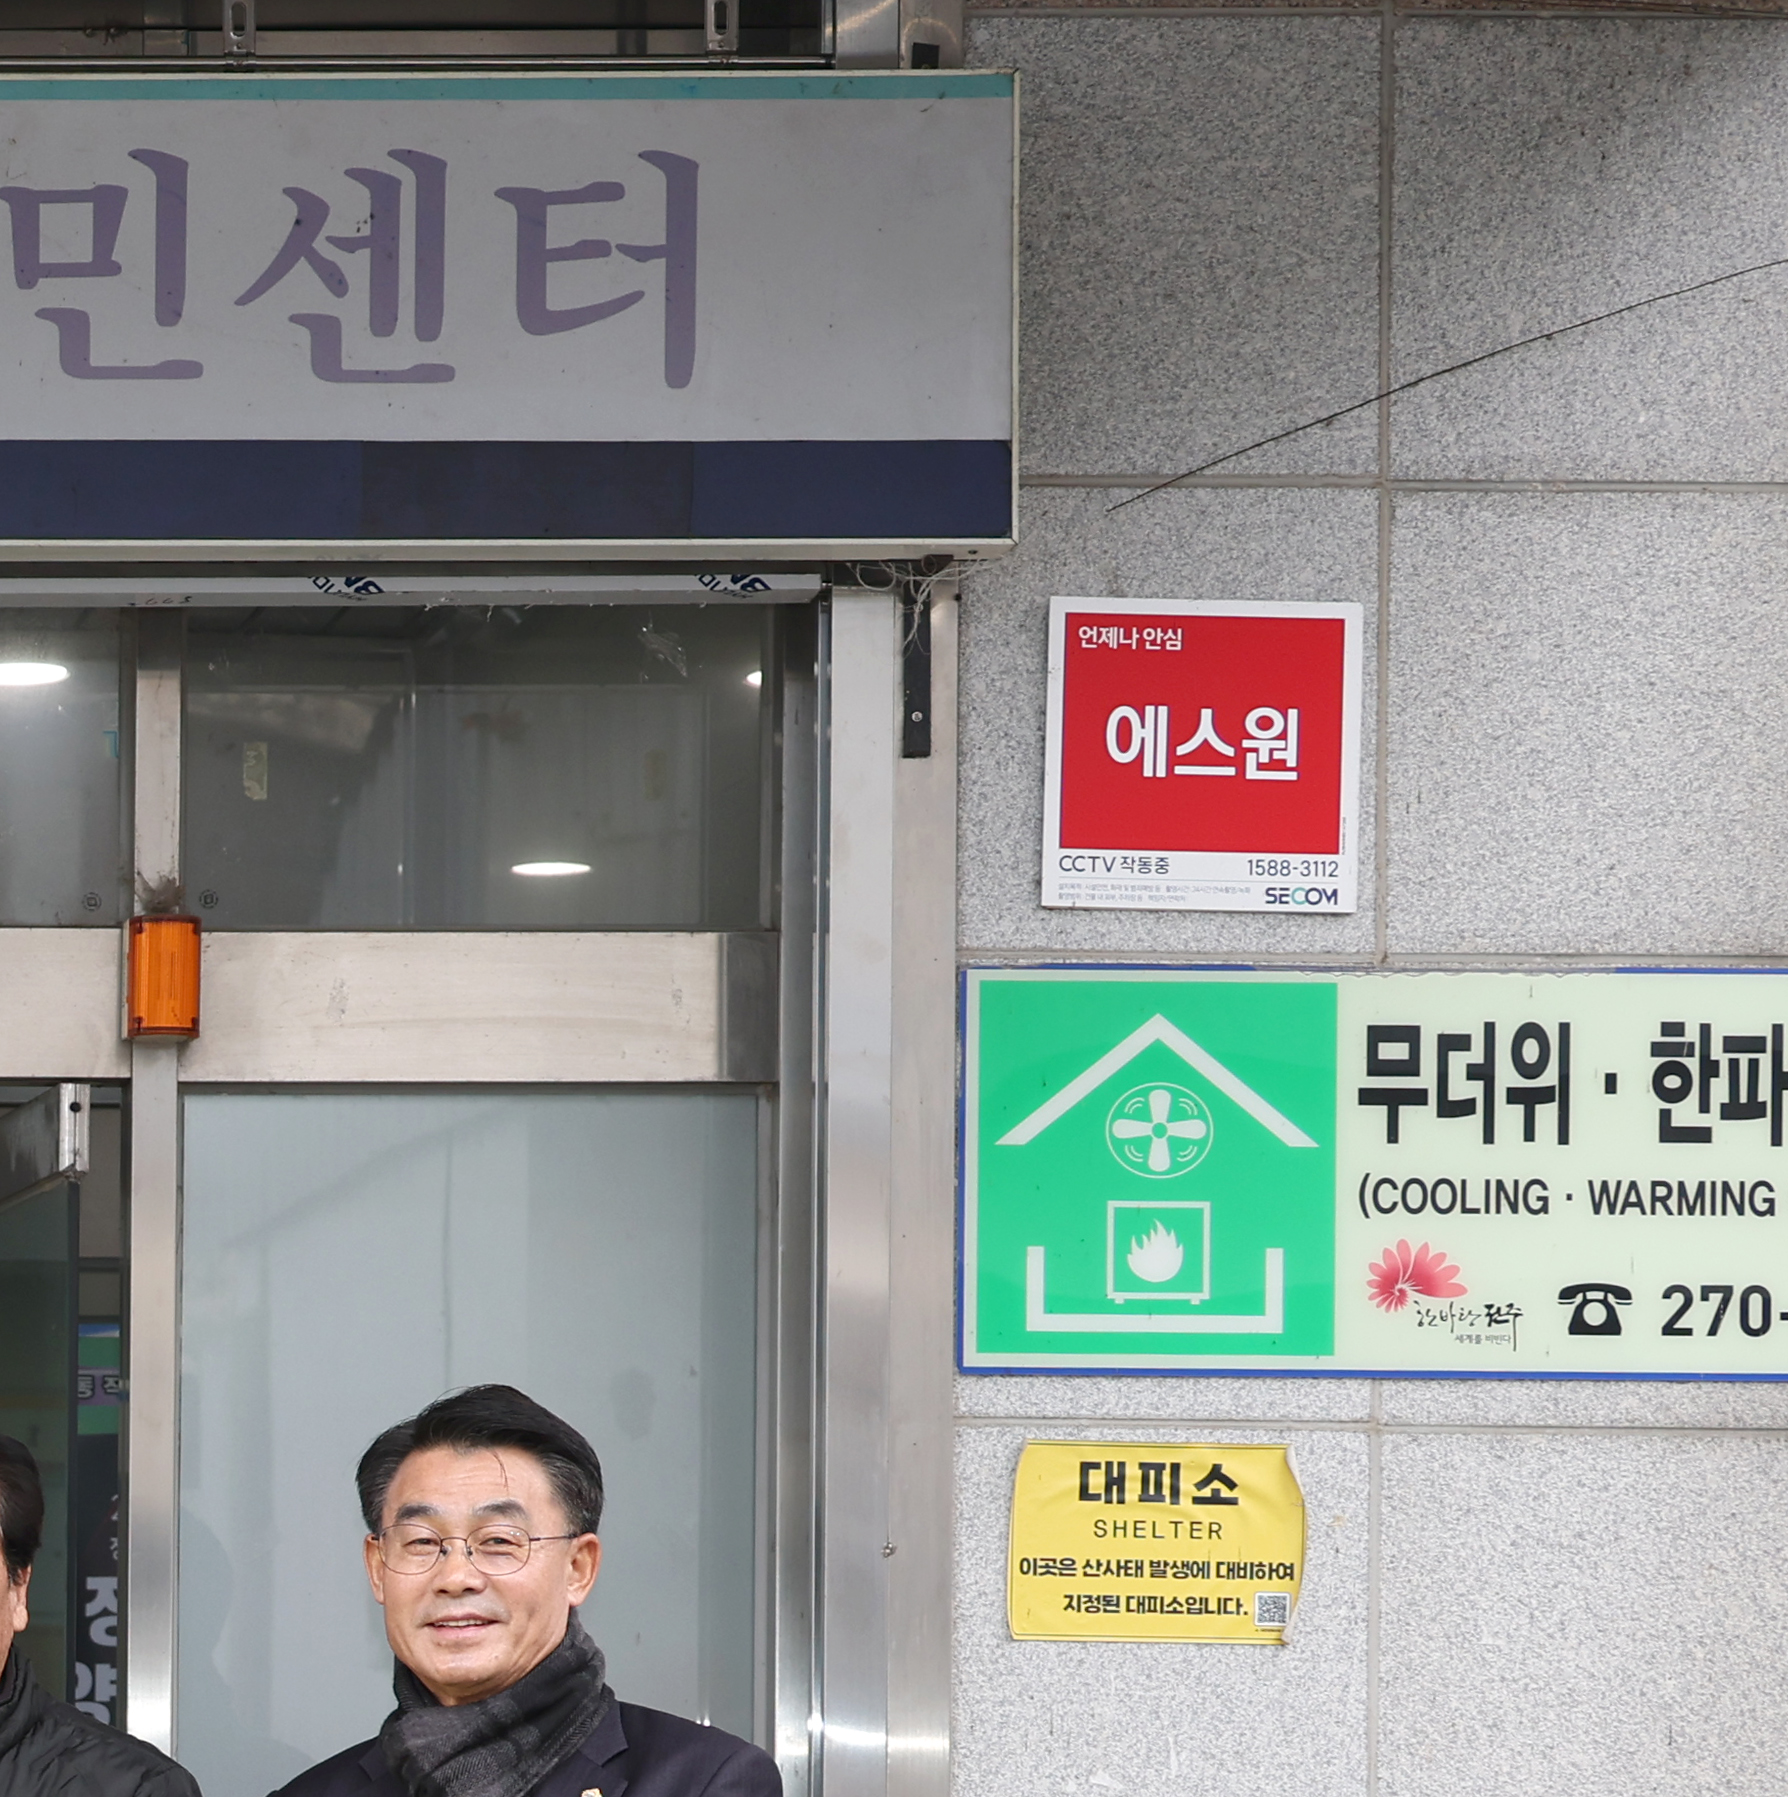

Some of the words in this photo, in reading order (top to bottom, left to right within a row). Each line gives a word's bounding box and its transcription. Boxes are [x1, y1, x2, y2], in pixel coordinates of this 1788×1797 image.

[1078, 626, 1140, 651] 언제나
[1142, 627, 1184, 652] 안심
[1107, 706, 1297, 780] 에스원
[1059, 855, 1116, 873] CCTV
[1120, 856, 1170, 874] 작동중
[1247, 859, 1339, 878] 1588-3112
[1265, 887, 1338, 905] SECOM
[1358, 1022, 1570, 1145] 무더위
[1650, 1021, 1788, 1147] 한파
[1358, 1173, 1550, 1219] (COOLING
[1588, 1179, 1777, 1217] WARMING
[1454, 1333, 1483, 1345] 세계를
[1483, 1303, 1524, 1352] 전주
[1078, 1460, 1240, 1507] 대피소
[1093, 1519, 1223, 1541] SHELTER
[1018, 1557, 1077, 1579] 이곳은
[1081, 1558, 1145, 1579] 산사태
[1149, 1560, 1210, 1580] 발생에
[1215, 1561, 1295, 1581] 대비하여
[1062, 1593, 1121, 1615] 지정된
[1125, 1595, 1249, 1616] 대피소입니다.
